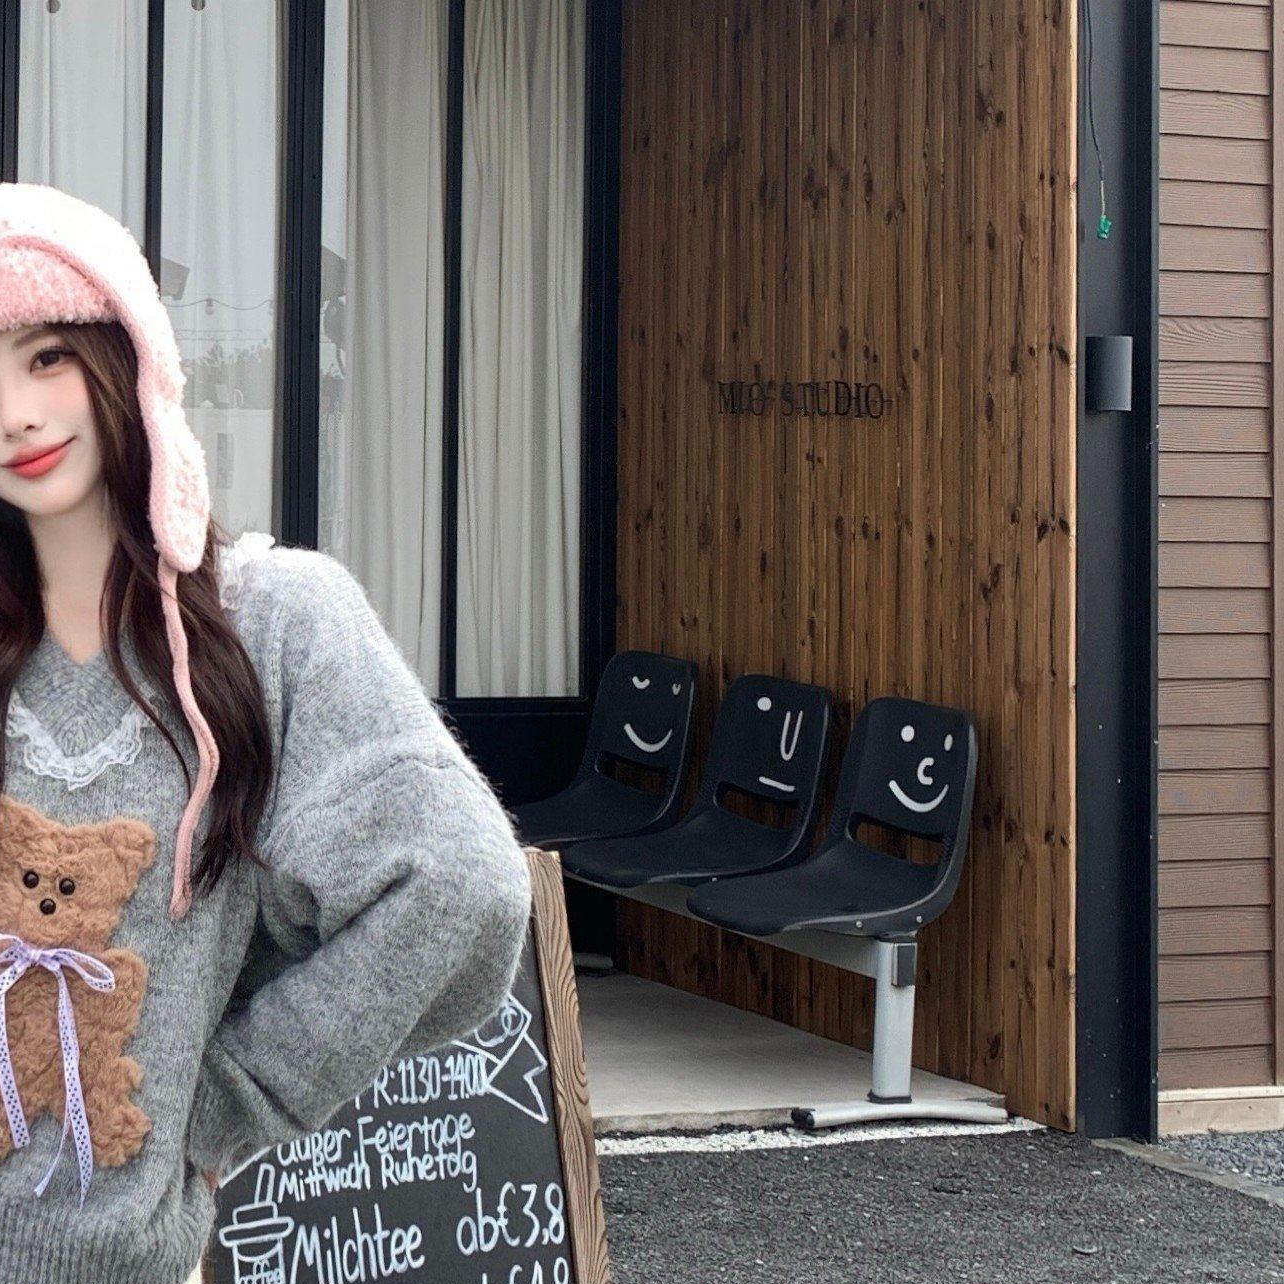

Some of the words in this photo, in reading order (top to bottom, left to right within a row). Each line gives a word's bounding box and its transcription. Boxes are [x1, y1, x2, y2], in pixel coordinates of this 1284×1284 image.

[781, 379, 884, 419] STUDIO
[357, 1112, 476, 1172] Feiertage
[277, 1149, 371, 1203] Mittwoch
[380, 1150, 477, 1193] Ruhetag
